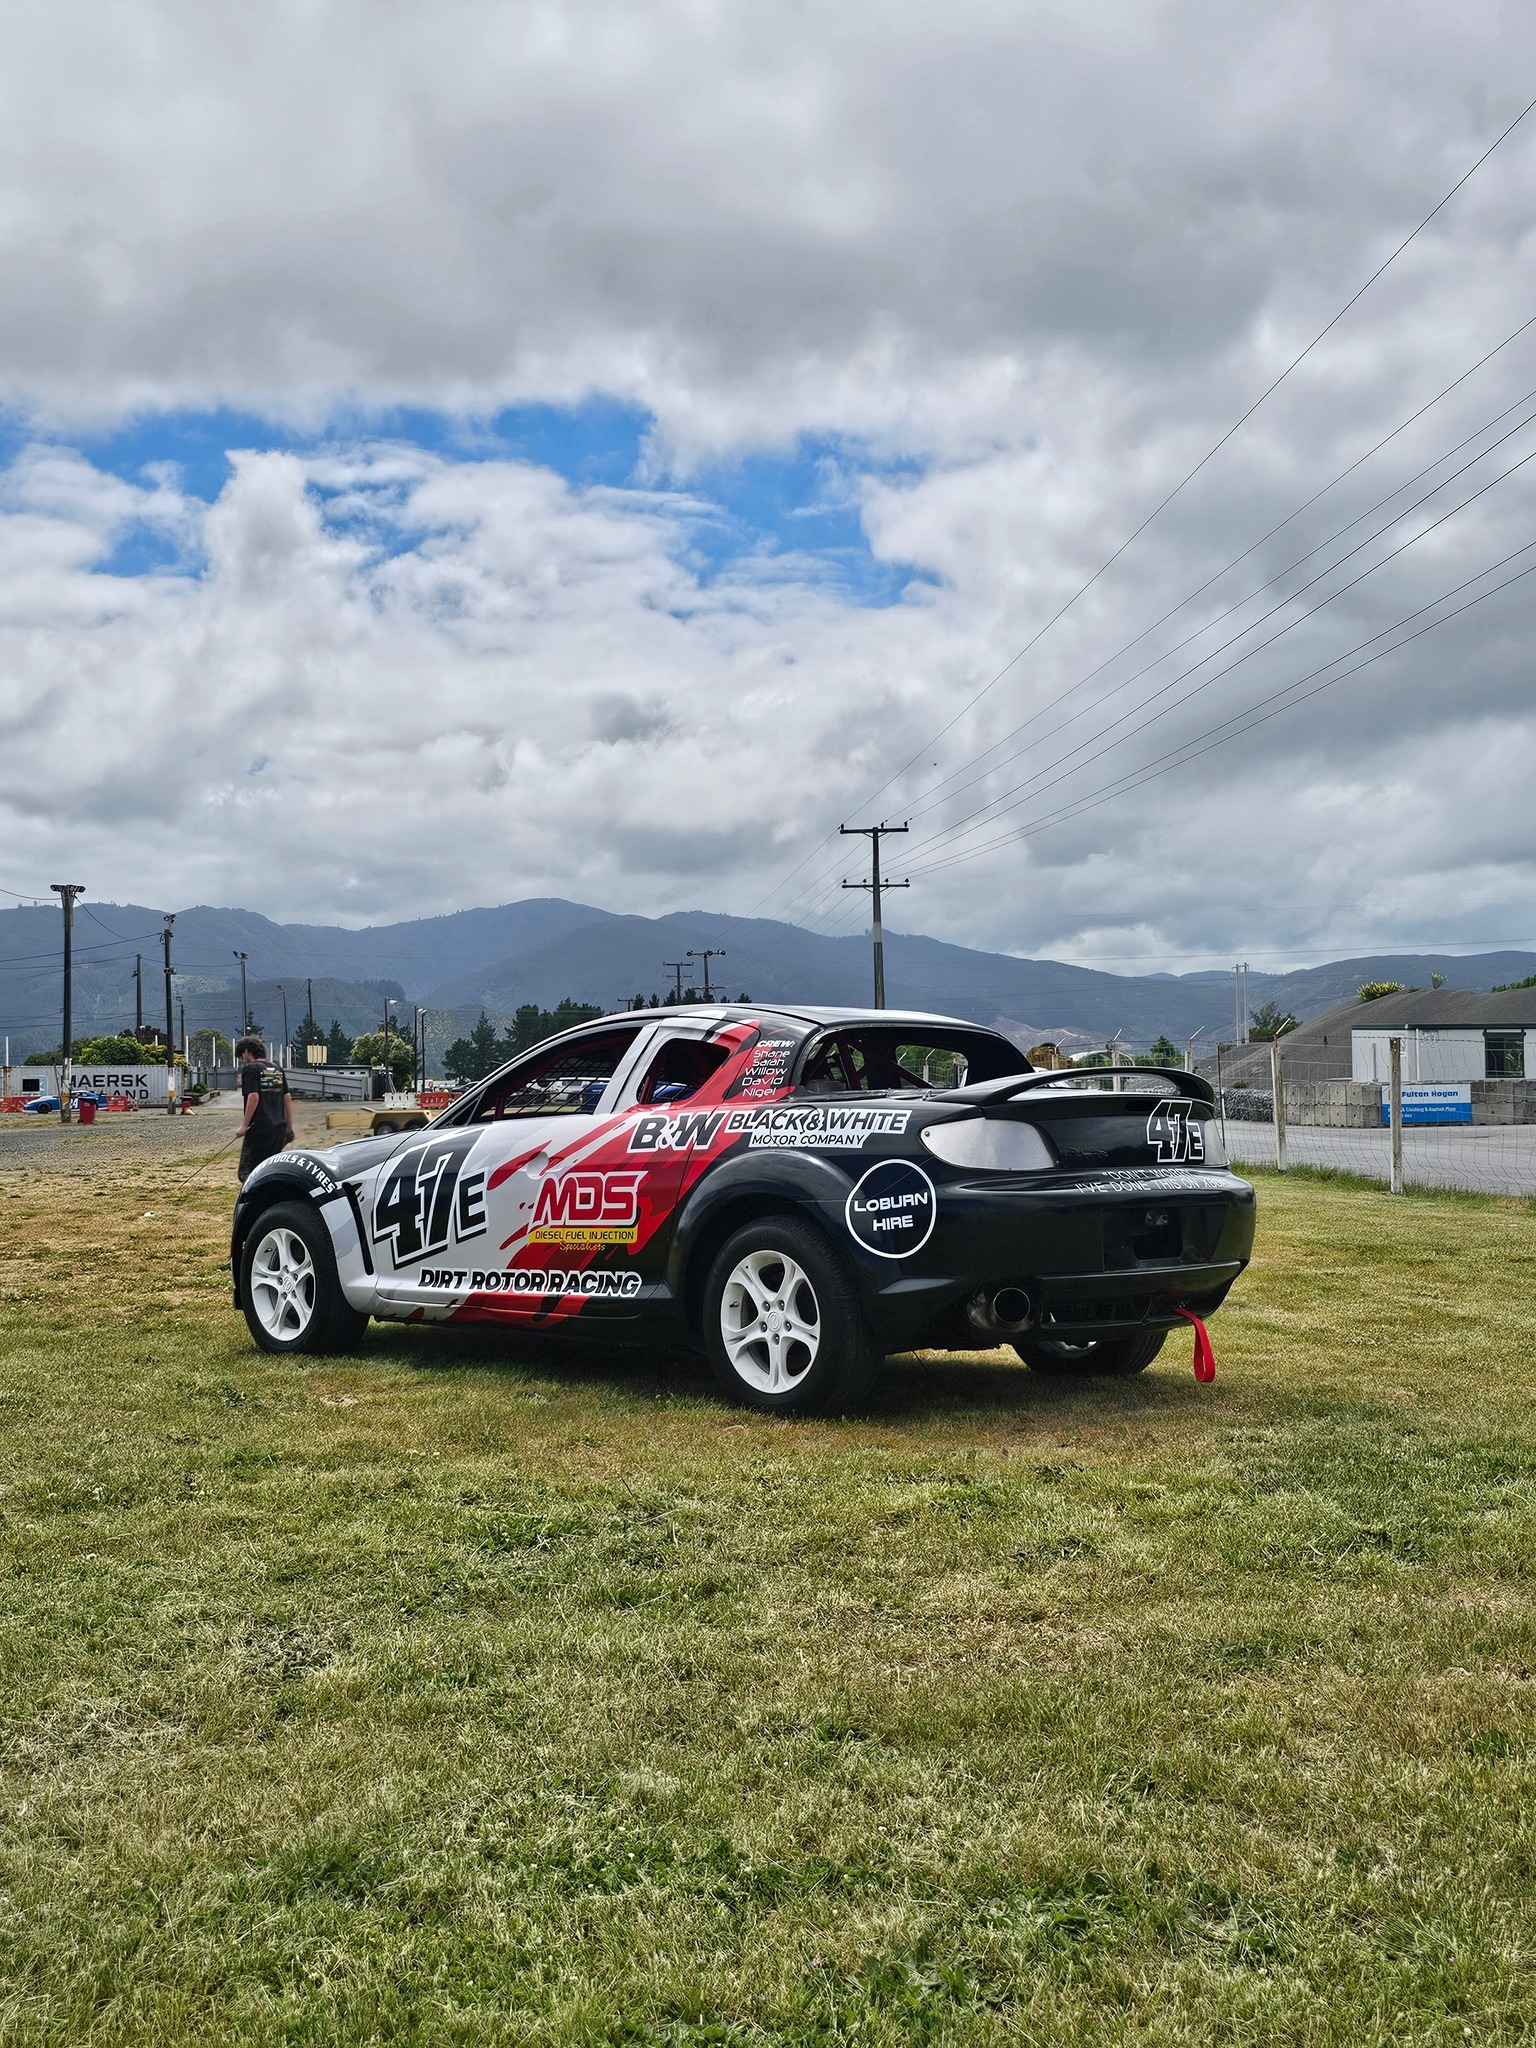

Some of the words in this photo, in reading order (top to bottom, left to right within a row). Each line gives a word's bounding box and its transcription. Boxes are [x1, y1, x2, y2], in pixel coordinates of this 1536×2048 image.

[757, 1040, 796, 1048] CREW:
[752, 1058, 785, 1067] Sarah
[753, 1050, 791, 1058] Shane
[745, 1067, 788, 1075] Willow
[742, 1076, 784, 1086] David
[742, 1087, 777, 1098] Nigel
[1431, 1090, 1459, 1098] Hogan
[728, 1111, 802, 1131] BLACK
[829, 1111, 907, 1131] WHITE
[628, 1111, 729, 1152] B&W
[1146, 1099, 1204, 1163] 47E
[751, 1134, 797, 1145] MOTOR
[800, 1134, 864, 1146] COMPANY
[269, 1154, 298, 1165] TOOLS
[297, 1156, 307, 1167] &
[305, 1161, 336, 1194] TYRES
[1074, 1181, 1109, 1194] I'VE
[1109, 1180, 1152, 1192] DONE
[1151, 1179, 1181, 1189] THIS
[1180, 1177, 1200, 1189] ON
[371, 1128, 489, 1270] 47E
[529, 1172, 642, 1226] MDS
[854, 1191, 929, 1212] LOBURN
[872, 1214, 914, 1232] HIRE
[535, 1230, 564, 1240] DIESEL
[565, 1230, 587, 1240] FUEL
[588, 1230, 634, 1240] INJECTION
[417, 1267, 468, 1289] DIRT
[468, 1270, 546, 1293] ROTOR
[549, 1271, 642, 1297] RACING
